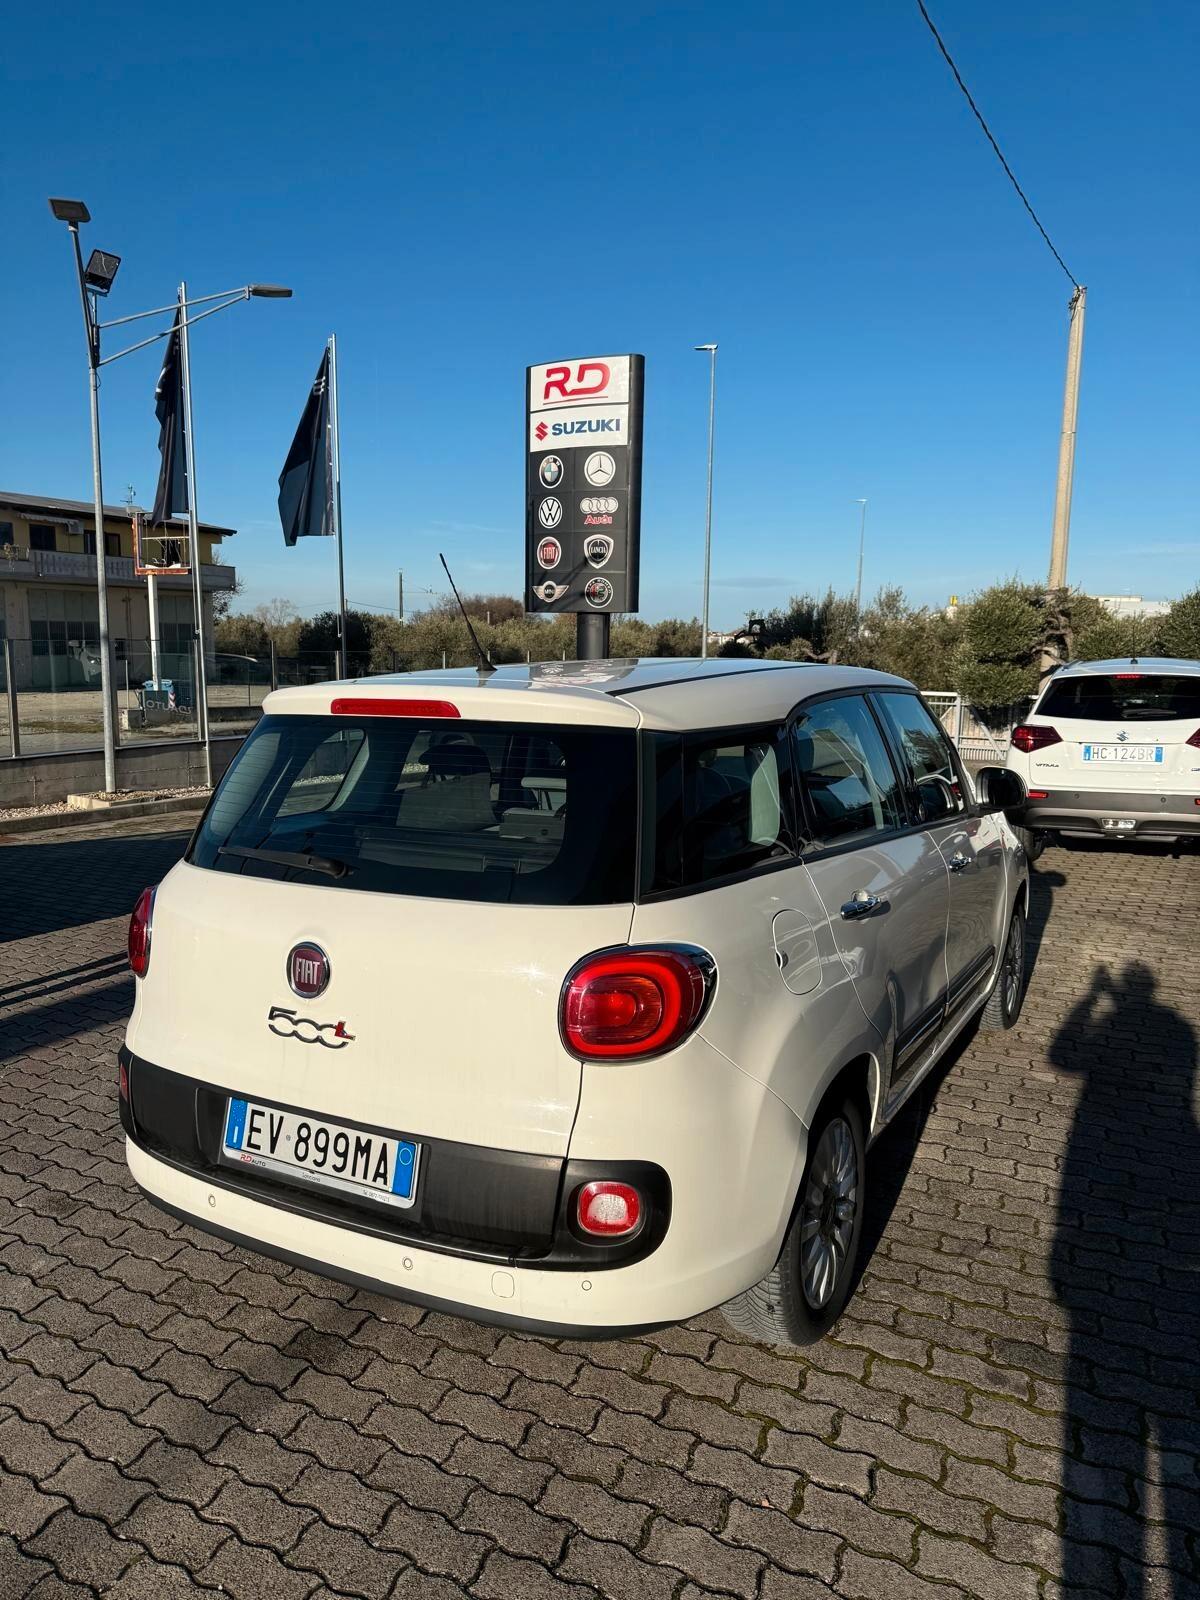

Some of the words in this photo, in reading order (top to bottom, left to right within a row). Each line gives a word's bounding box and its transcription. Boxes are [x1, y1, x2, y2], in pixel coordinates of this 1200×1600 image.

[543, 363, 611, 400] RD
[551, 419, 621, 436] SUZUKI
[584, 514, 613, 525] Audi
[543, 547, 556, 560] FIAT
[1092, 747, 1108, 760] HC
[1114, 748, 1154, 761] 124BR
[295, 957, 321, 985] FIAT
[268, 1006, 357, 1050] 500L
[246, 1108, 284, 1154] EV
[293, 1122, 388, 1186] 899MA
